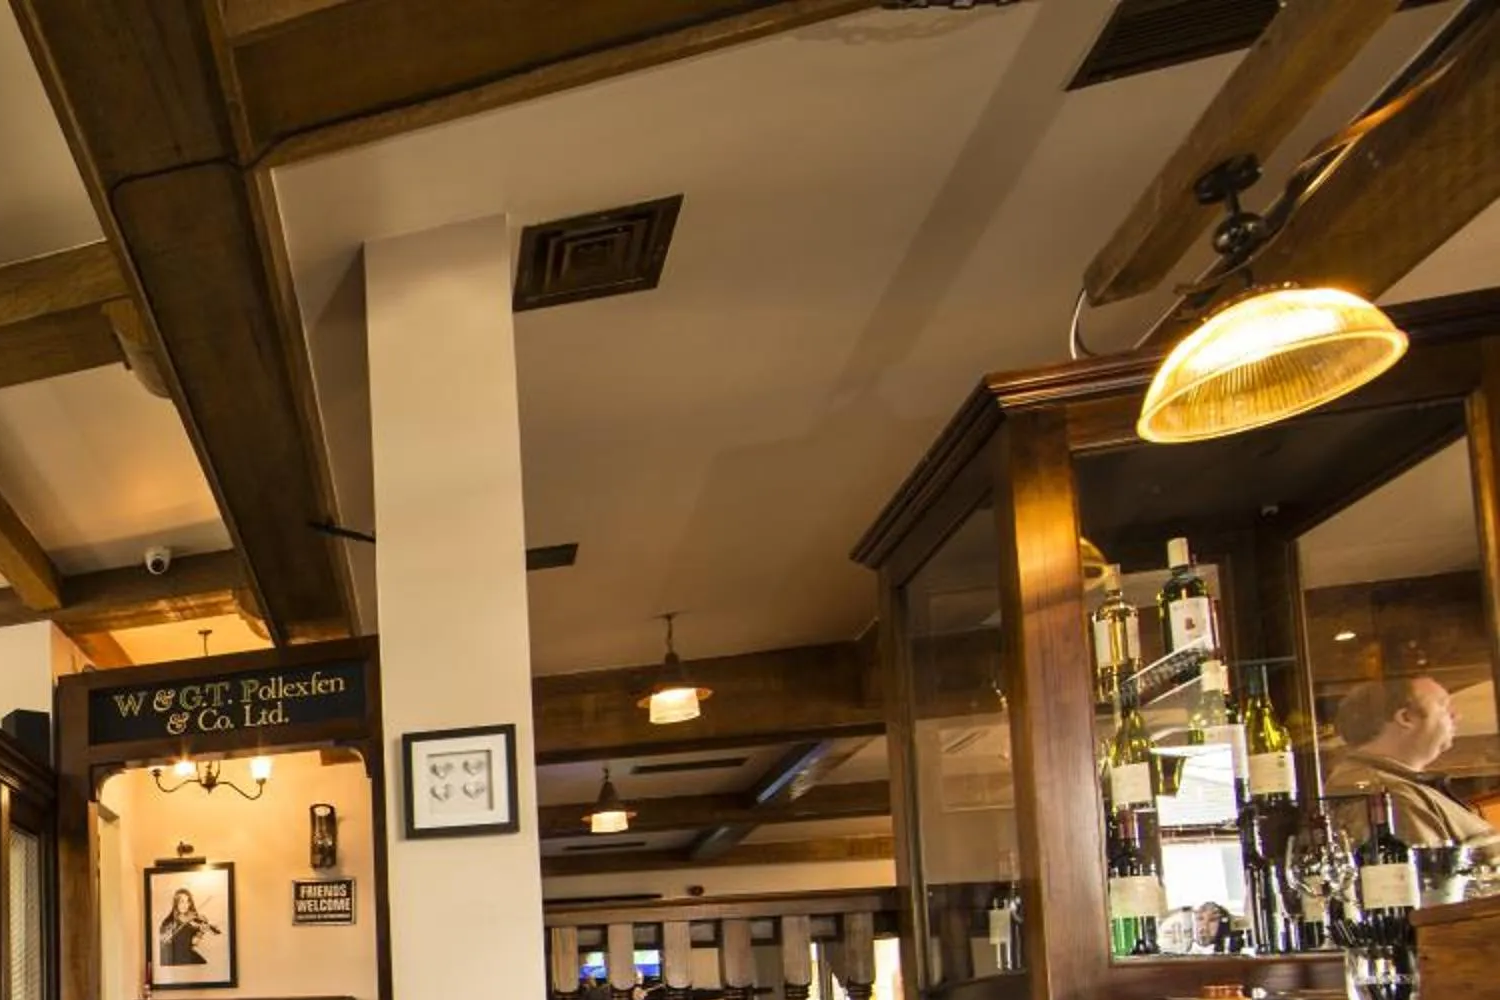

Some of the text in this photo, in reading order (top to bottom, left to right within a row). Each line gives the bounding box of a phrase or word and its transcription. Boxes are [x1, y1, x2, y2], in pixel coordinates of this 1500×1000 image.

[153, 688, 176, 712] &
[240, 671, 345, 702] Pollexfen
[166, 701, 290, 735] & Co. Ltd.
[300, 883, 347, 899] FRIENDS
[296, 897, 351, 912] WELCOME
